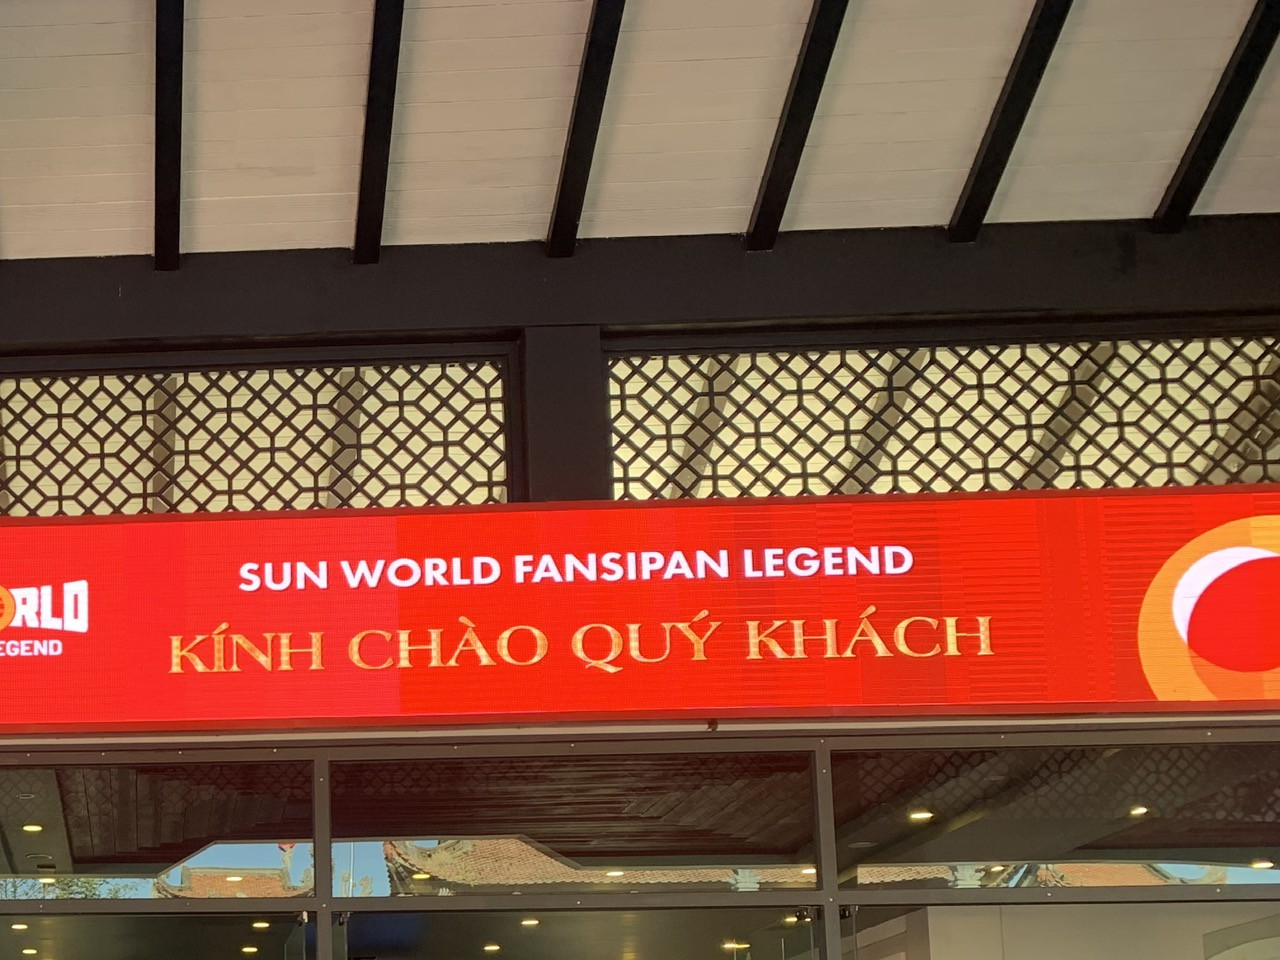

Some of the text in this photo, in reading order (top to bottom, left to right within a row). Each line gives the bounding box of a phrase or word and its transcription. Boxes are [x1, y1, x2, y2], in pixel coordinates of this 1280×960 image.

[239, 546, 916, 593] SUN WORLD FANSIPAN LEGEND
[169, 606, 996, 675] KÍNH CHÀO QUÝ KHÁCH
